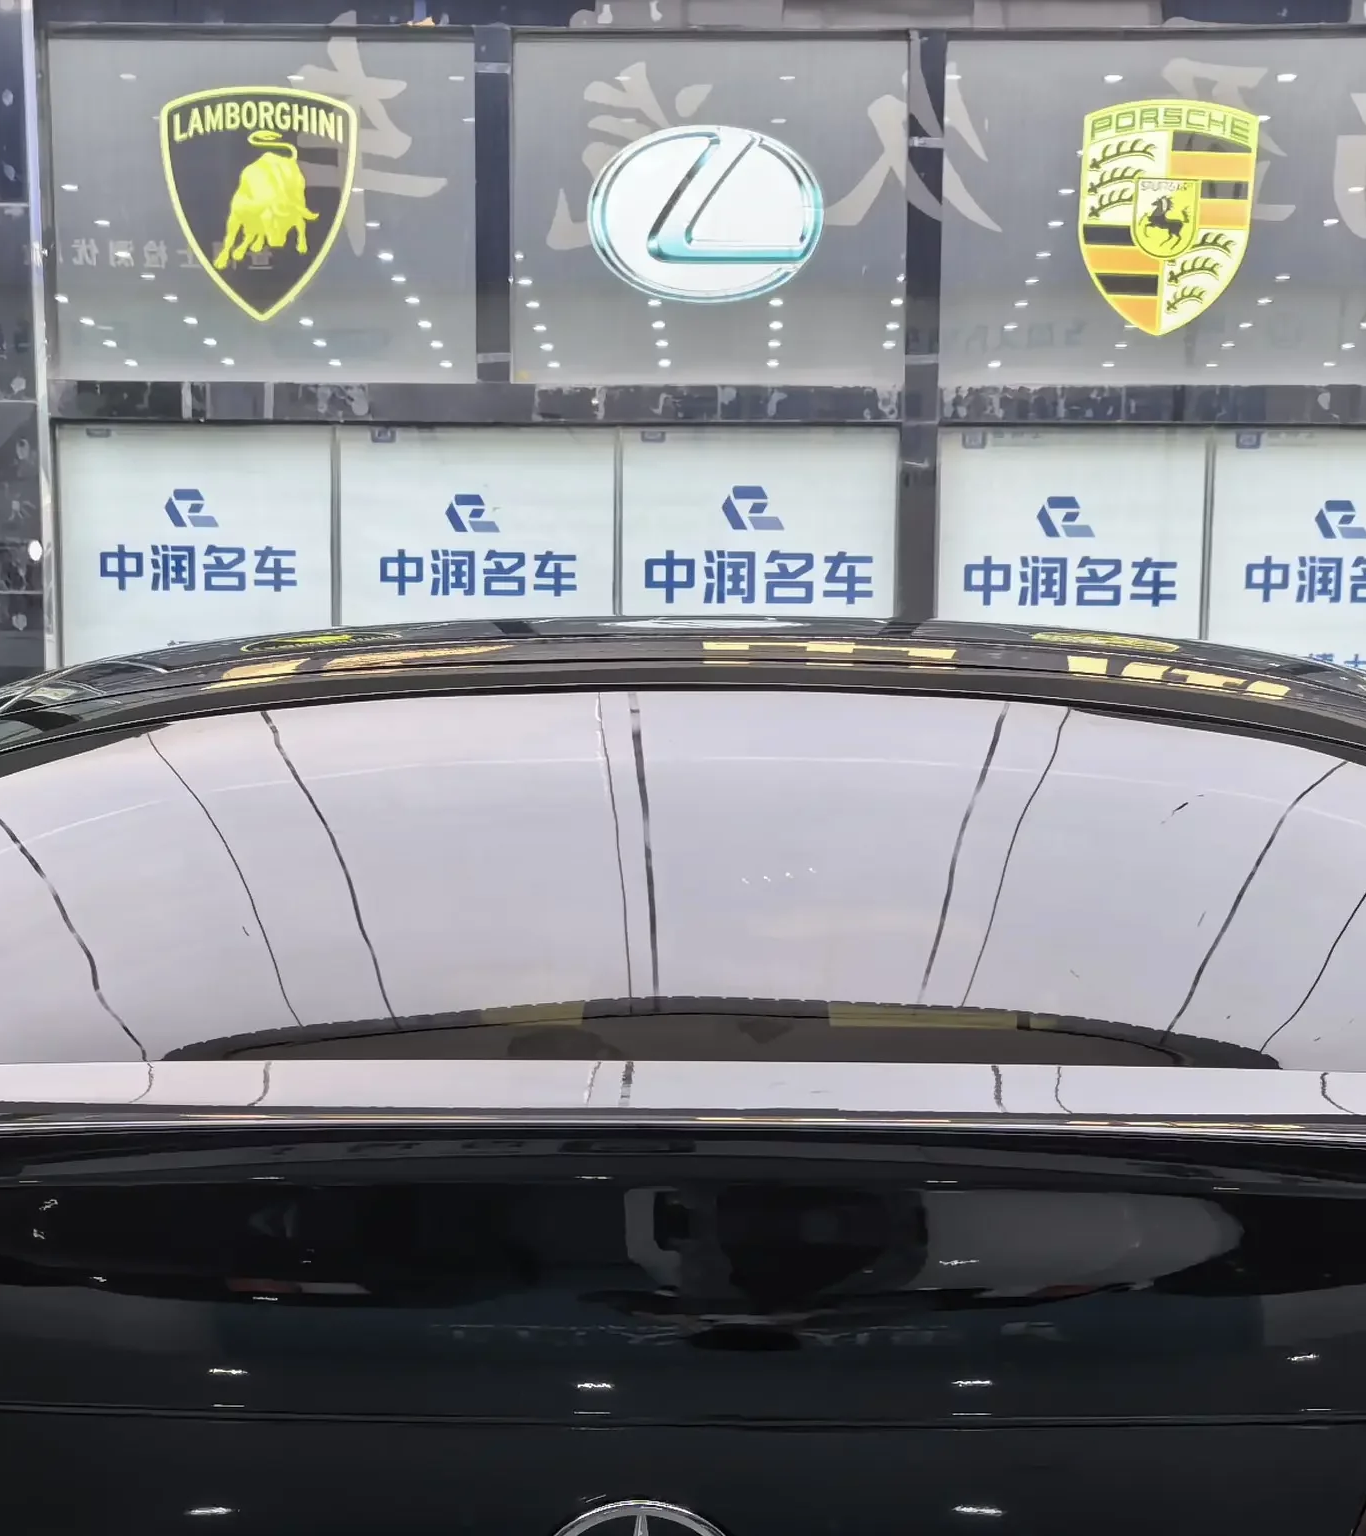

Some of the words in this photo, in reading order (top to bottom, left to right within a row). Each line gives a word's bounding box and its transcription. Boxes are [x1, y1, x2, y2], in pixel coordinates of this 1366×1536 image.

[173, 100, 344, 144] LAMBORGHINI
[1090, 107, 1250, 144] PORSCHE
[99, 544, 298, 592] 中润名车
[379, 549, 578, 597] 中润名车
[644, 550, 874, 606] 中润名车
[962, 556, 1178, 608] 中润名车
